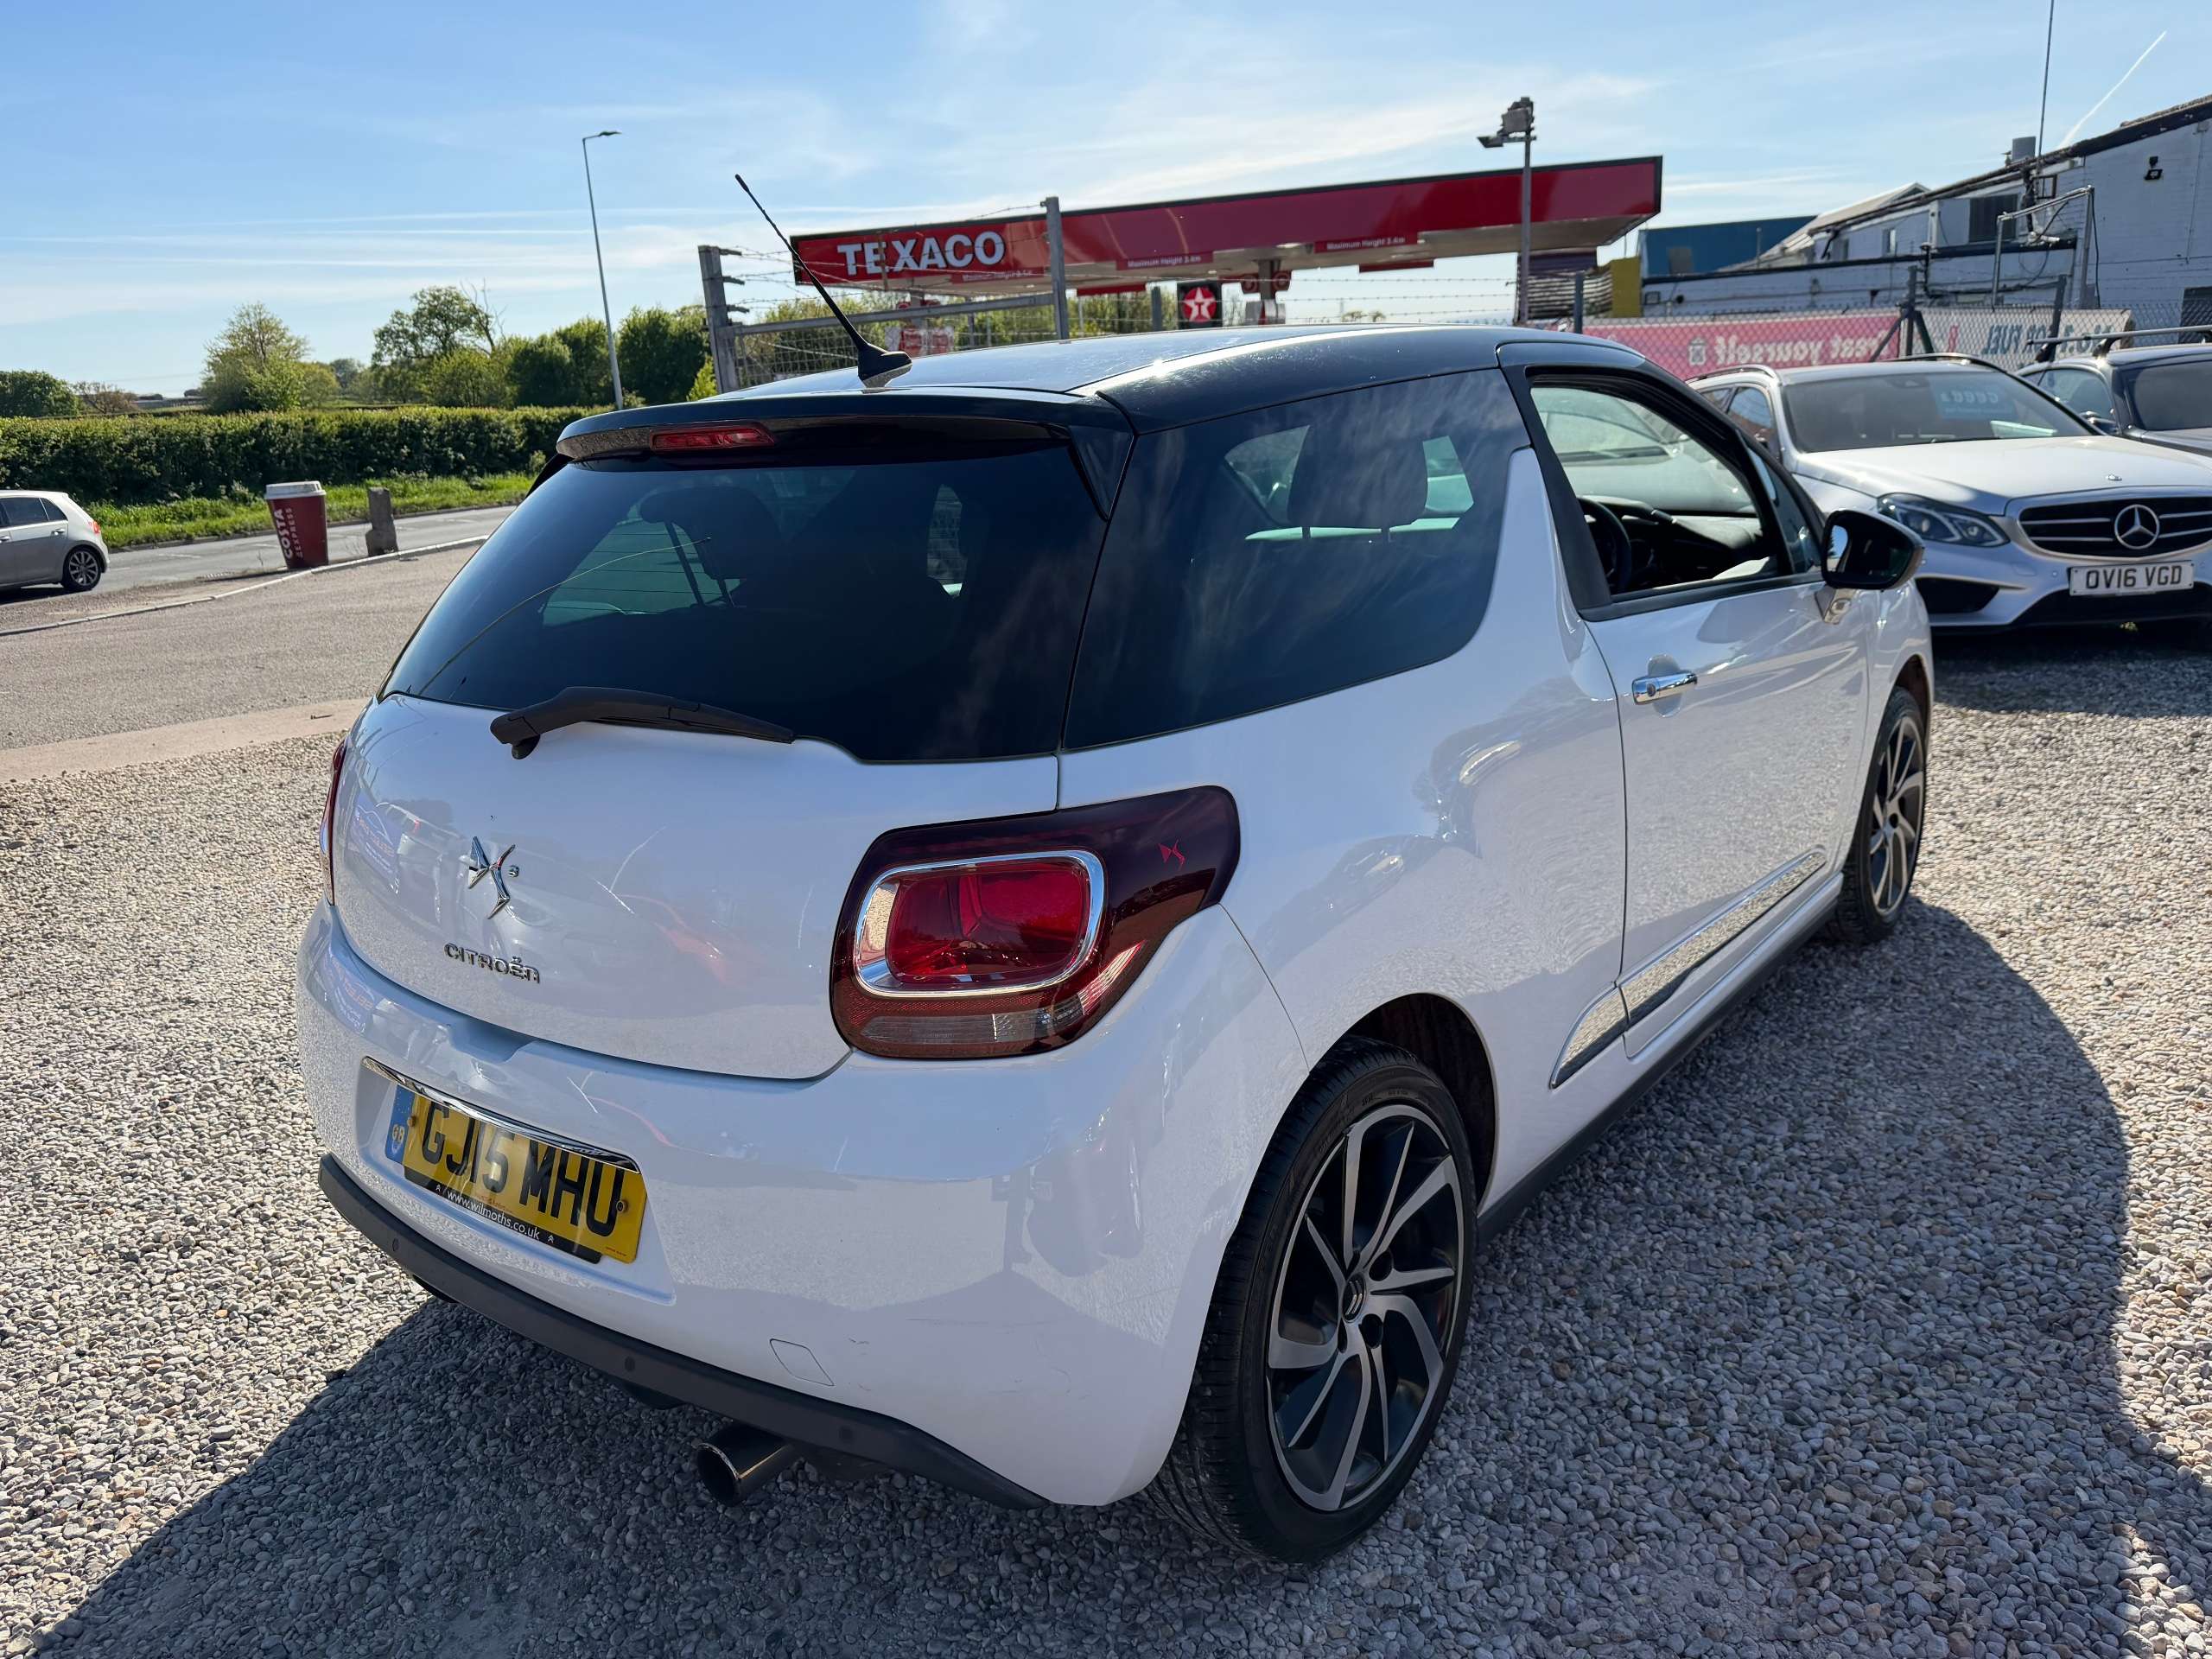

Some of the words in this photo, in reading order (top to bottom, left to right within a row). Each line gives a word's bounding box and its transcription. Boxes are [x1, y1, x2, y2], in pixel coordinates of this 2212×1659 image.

[836, 231, 1006, 276] TEXACO
[274, 508, 293, 559] COSTA
[2086, 569, 2138, 589] OV16
[2145, 565, 2183, 587] VGD
[391, 1122, 405, 1141] GB
[421, 1101, 516, 1194] GJ15
[518, 1140, 626, 1237] MHU
[447, 1191, 540, 1241] www.wilmoths.co.uk
